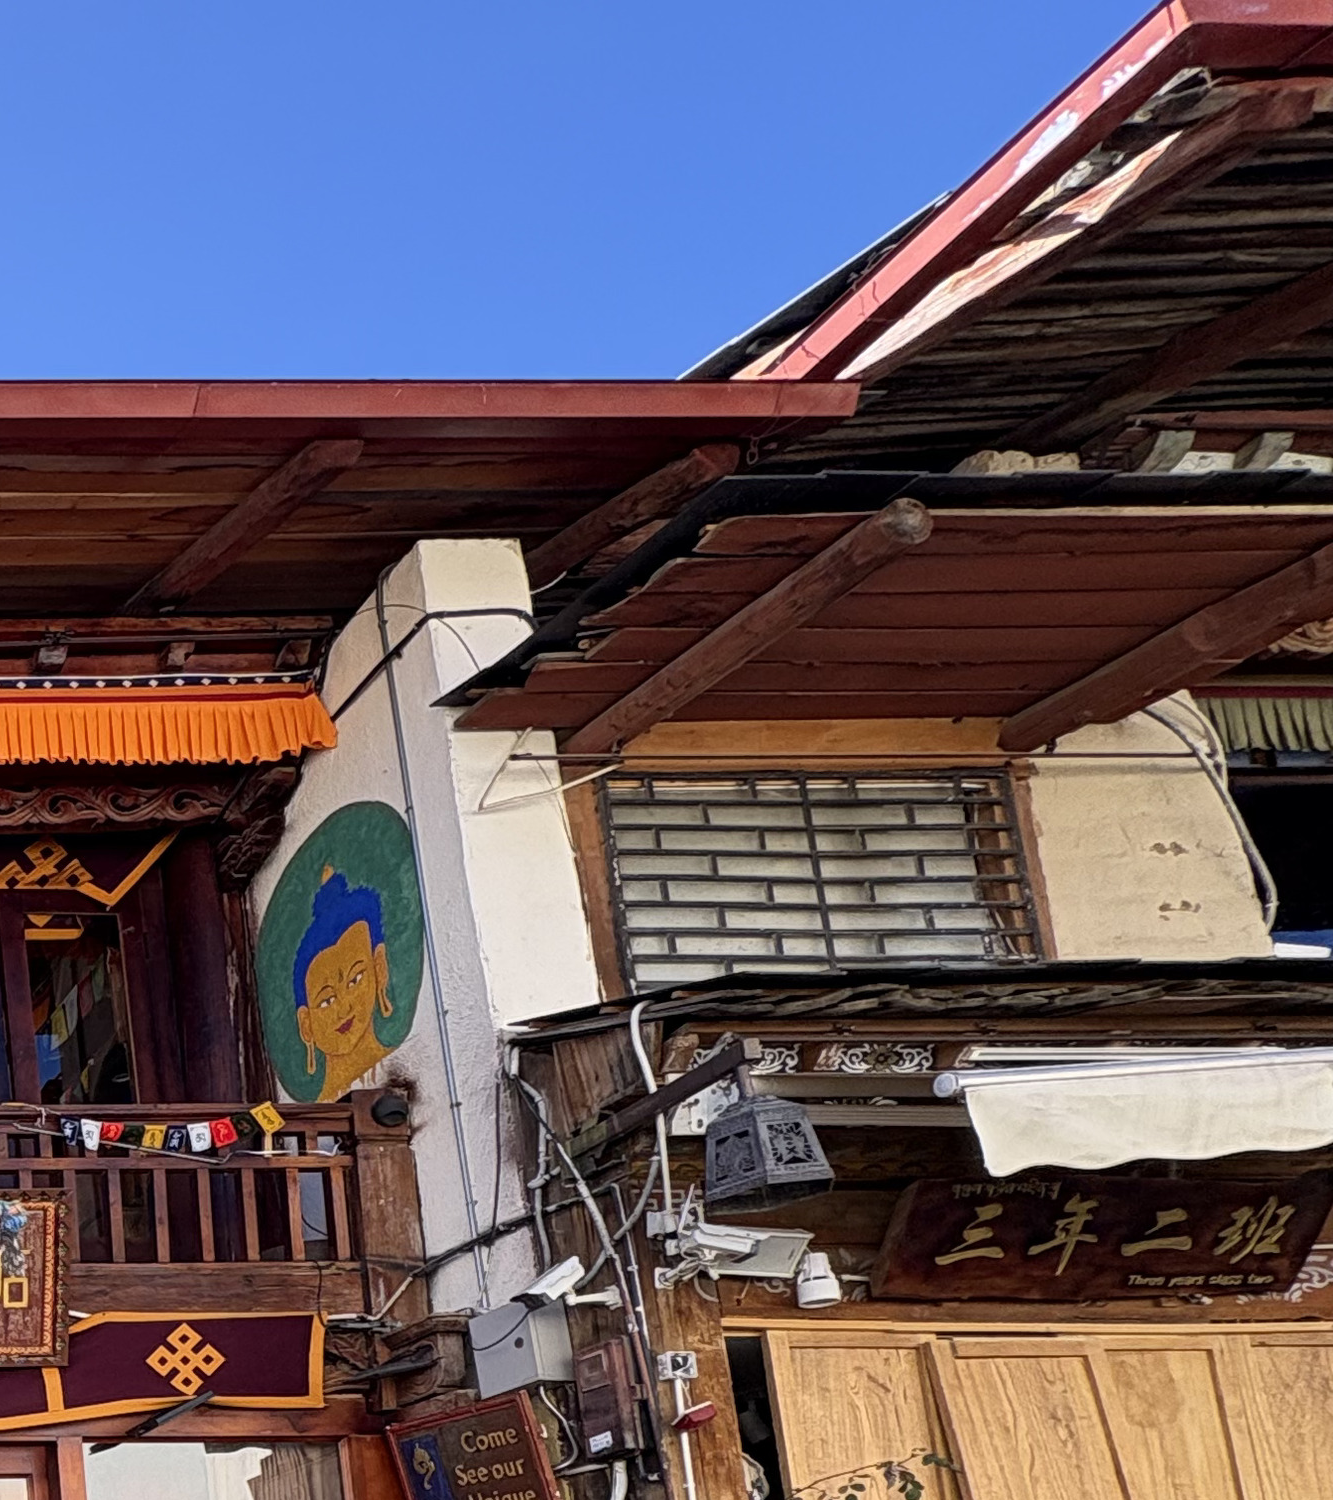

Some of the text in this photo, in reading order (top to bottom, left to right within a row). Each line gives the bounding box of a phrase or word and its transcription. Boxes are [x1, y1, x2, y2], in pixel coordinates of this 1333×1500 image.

[934, 1193, 1297, 1278] 三年二班
[1247, 1273, 1274, 1284] two
[460, 1427, 520, 1453] Come
[454, 1458, 525, 1487] See our
